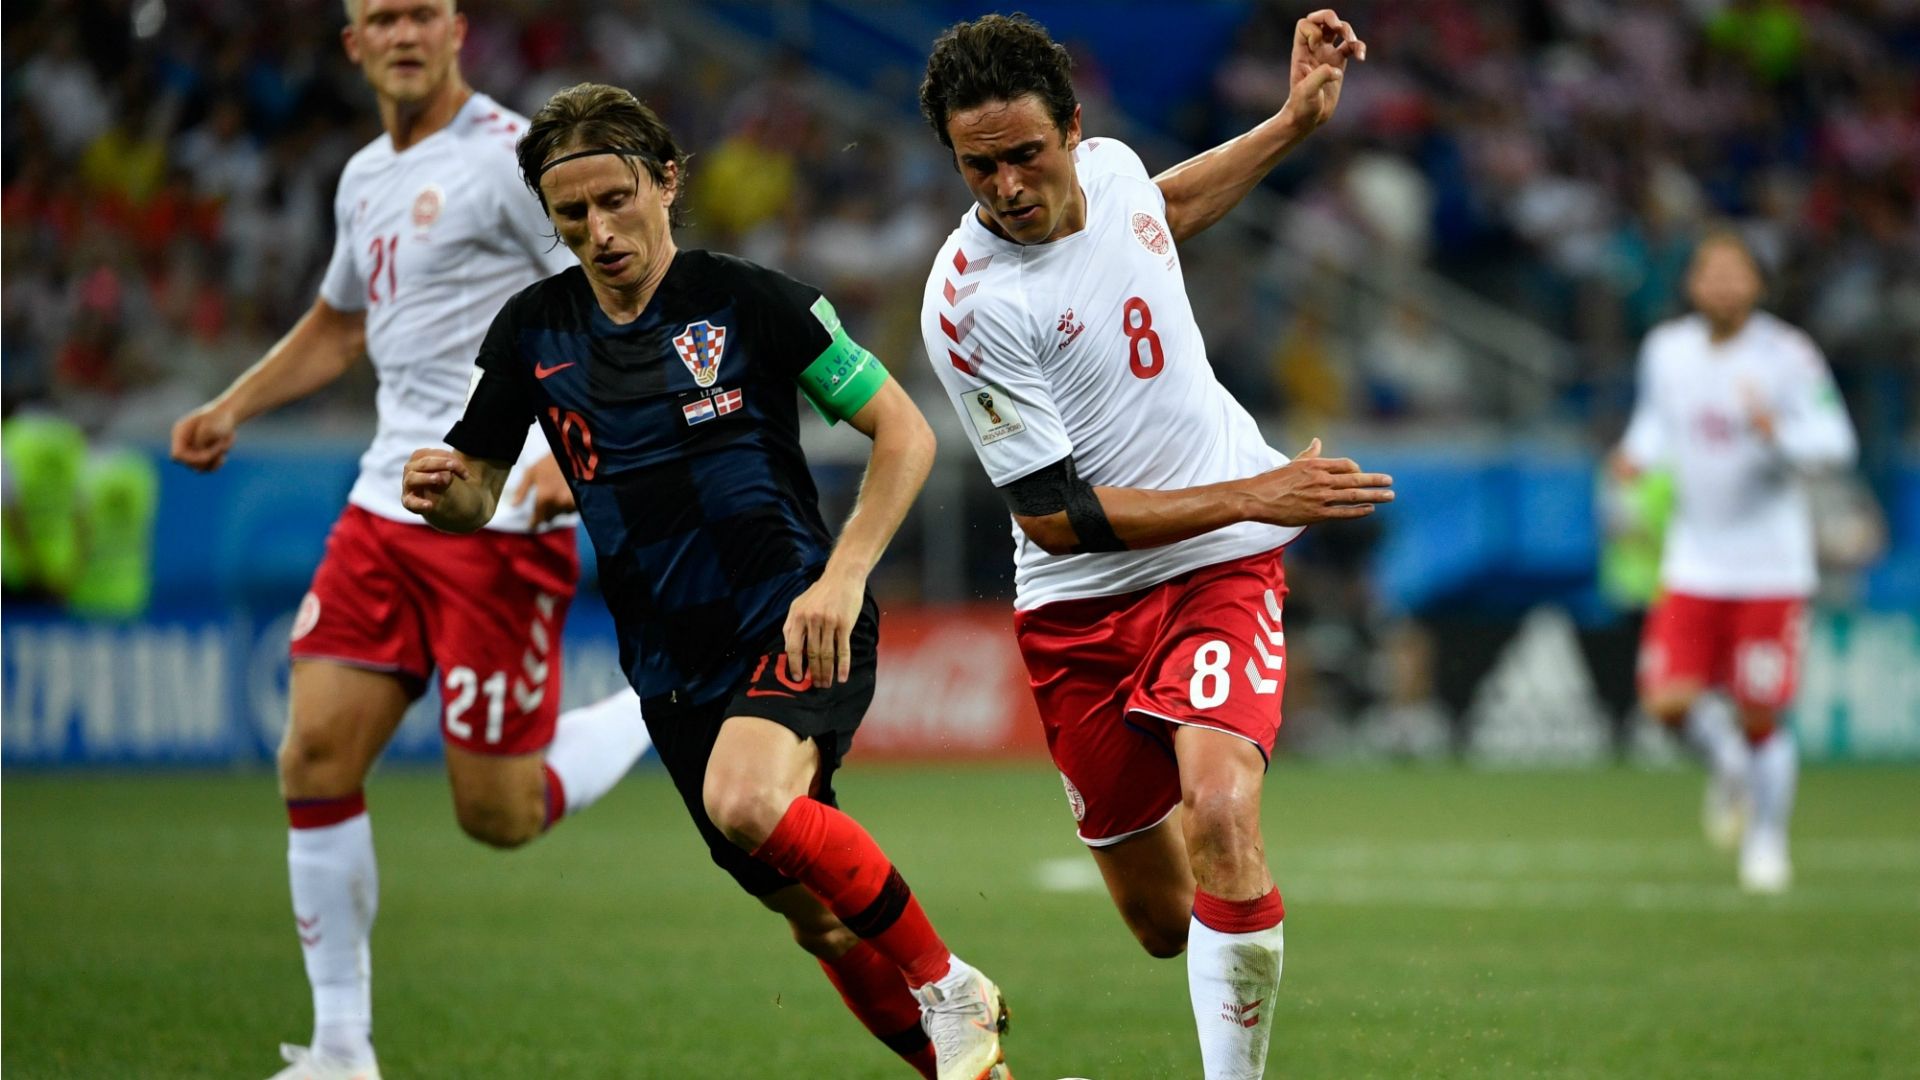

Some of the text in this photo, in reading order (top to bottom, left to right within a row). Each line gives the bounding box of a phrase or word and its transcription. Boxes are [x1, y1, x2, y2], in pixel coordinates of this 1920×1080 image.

[368, 236, 399, 303] 21
[1123, 296, 1165, 380] 8
[548, 407, 598, 481] 10
[446, 666, 507, 744] 21
[750, 653, 812, 691] 10
[1190, 639, 1231, 710] 8
